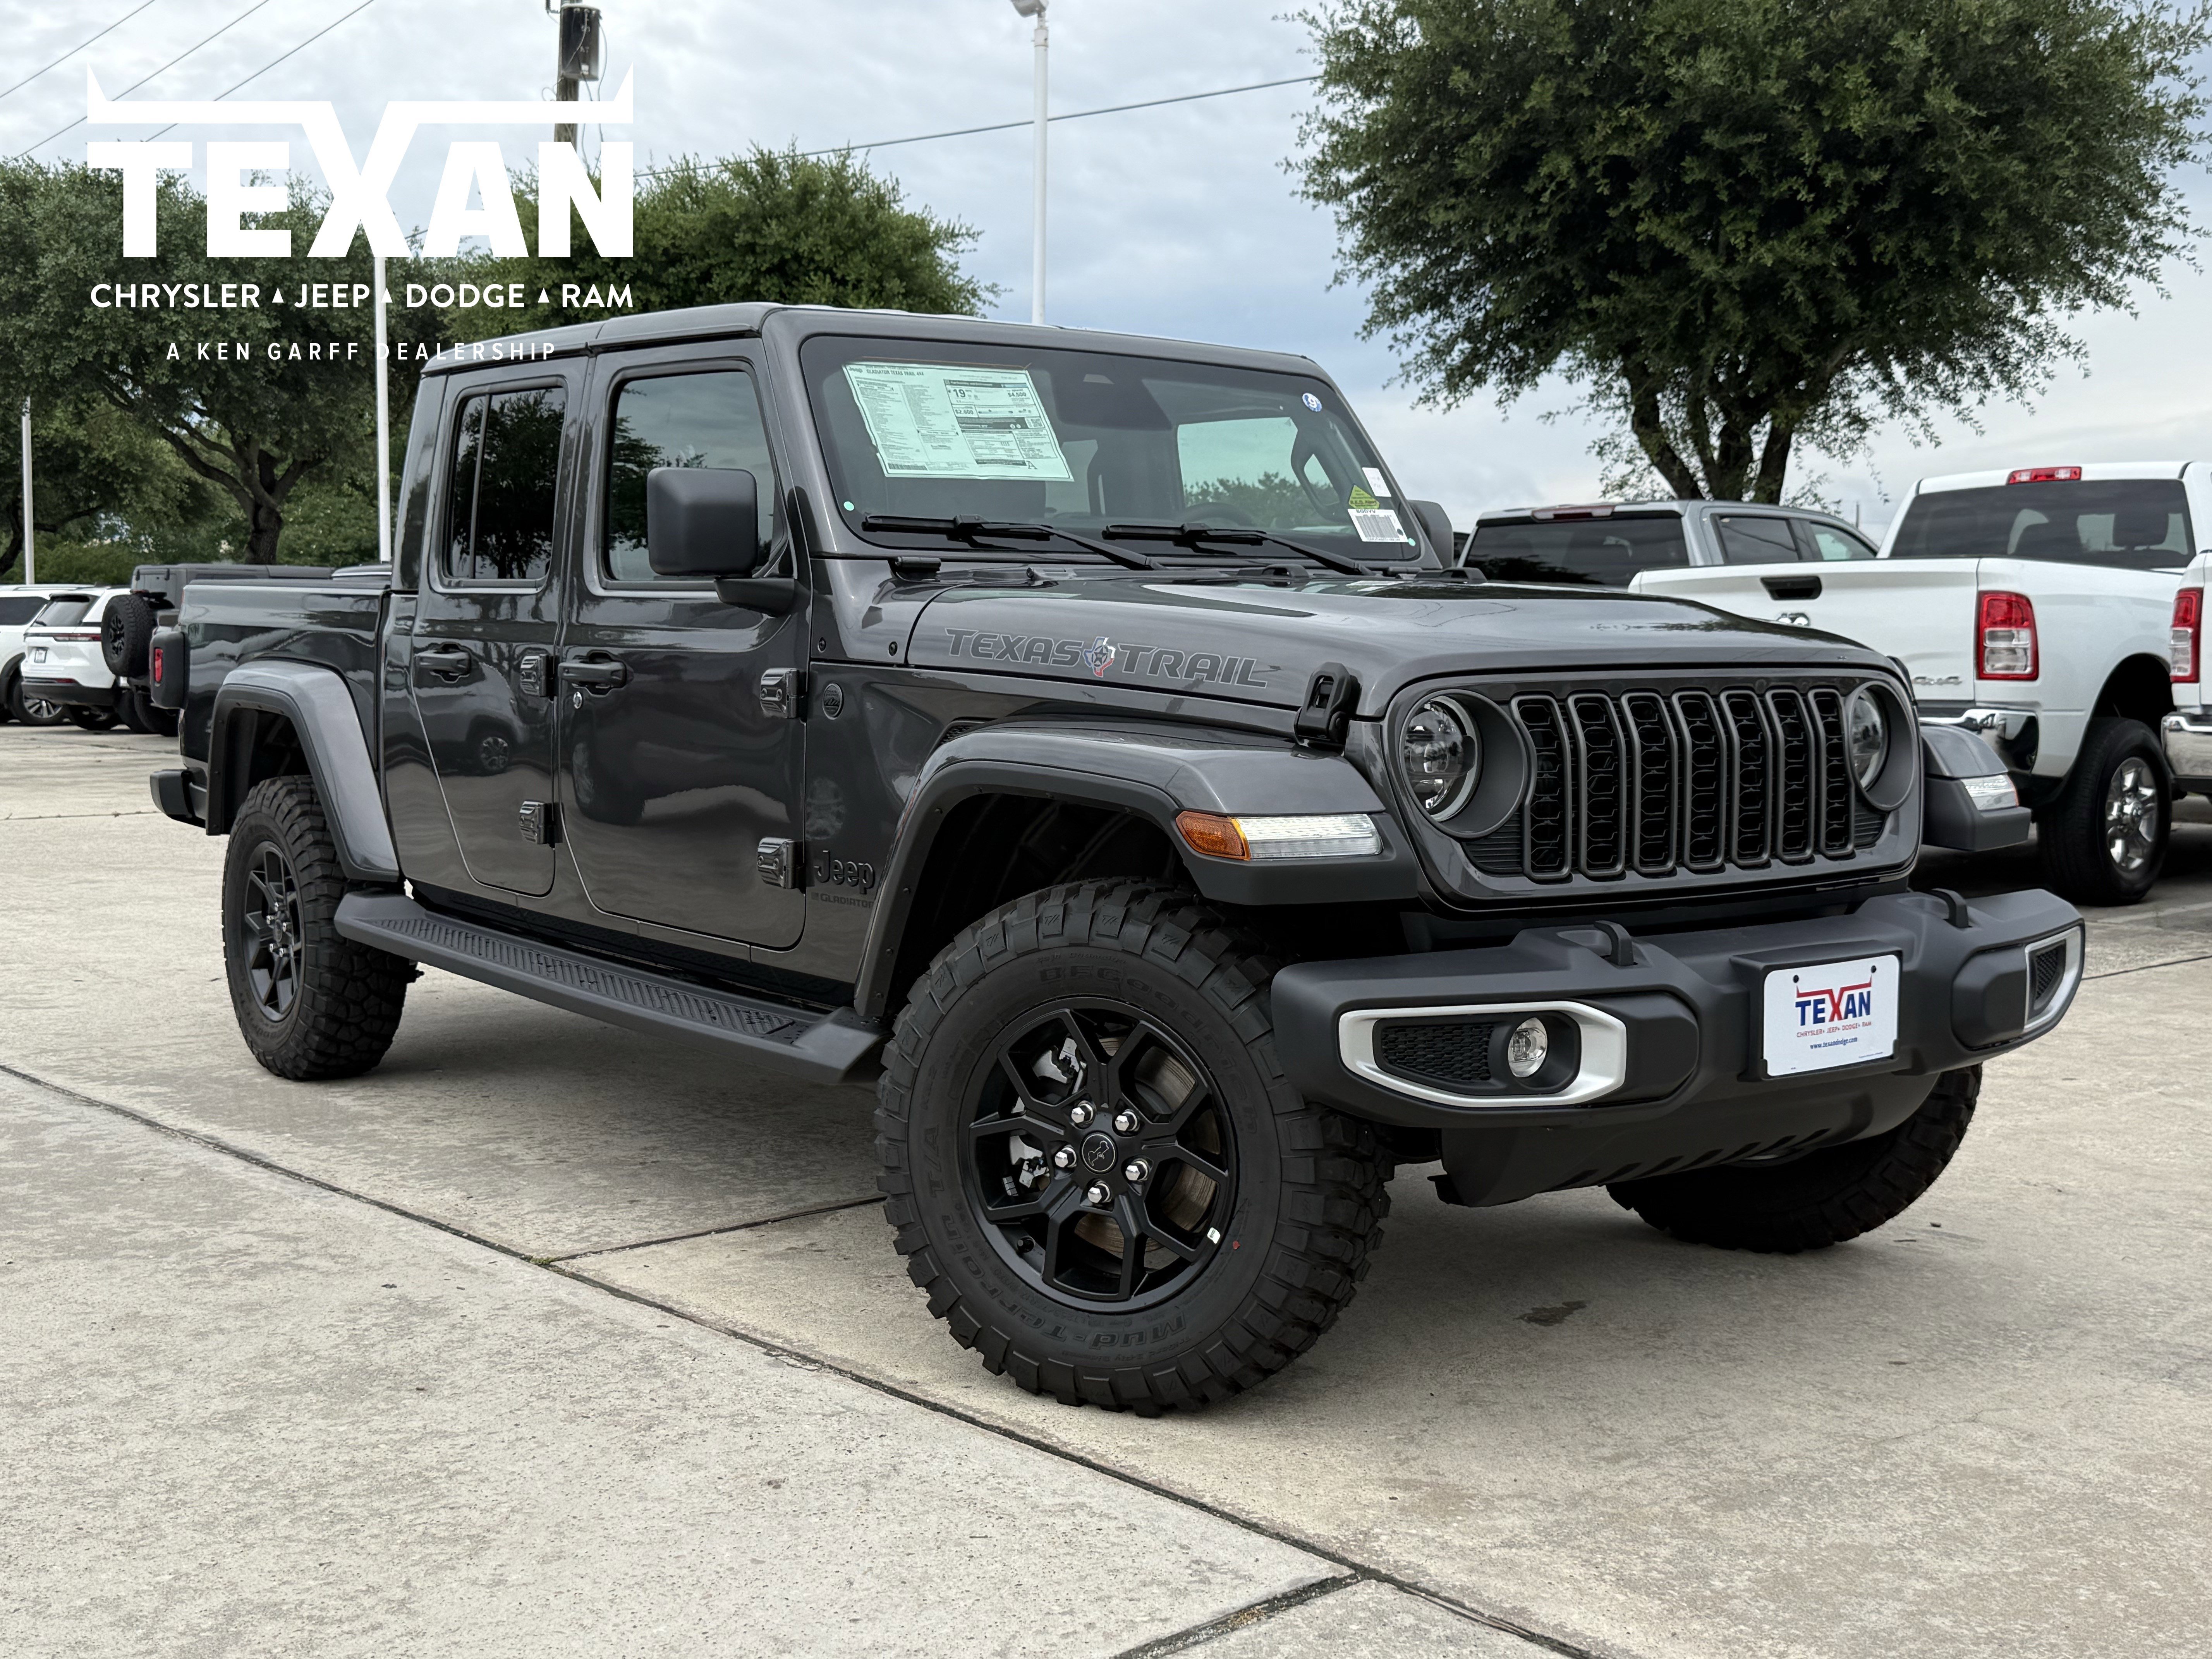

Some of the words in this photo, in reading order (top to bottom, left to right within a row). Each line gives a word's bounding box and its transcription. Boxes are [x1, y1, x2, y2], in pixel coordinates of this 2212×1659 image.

[953, 388, 966, 398] 19
[945, 628, 1084, 668] TEXAS
[1118, 643, 1268, 689] TRAIL
[814, 850, 875, 895] Jeep
[820, 893, 874, 908] GLADIATOR
[1795, 987, 1871, 1026] TEXAN
[1797, 1029, 1822, 1038] CHRYSLER
[1842, 1022, 1858, 1031] DODGE
[1810, 1037, 1858, 1049] www.texandodge.com
